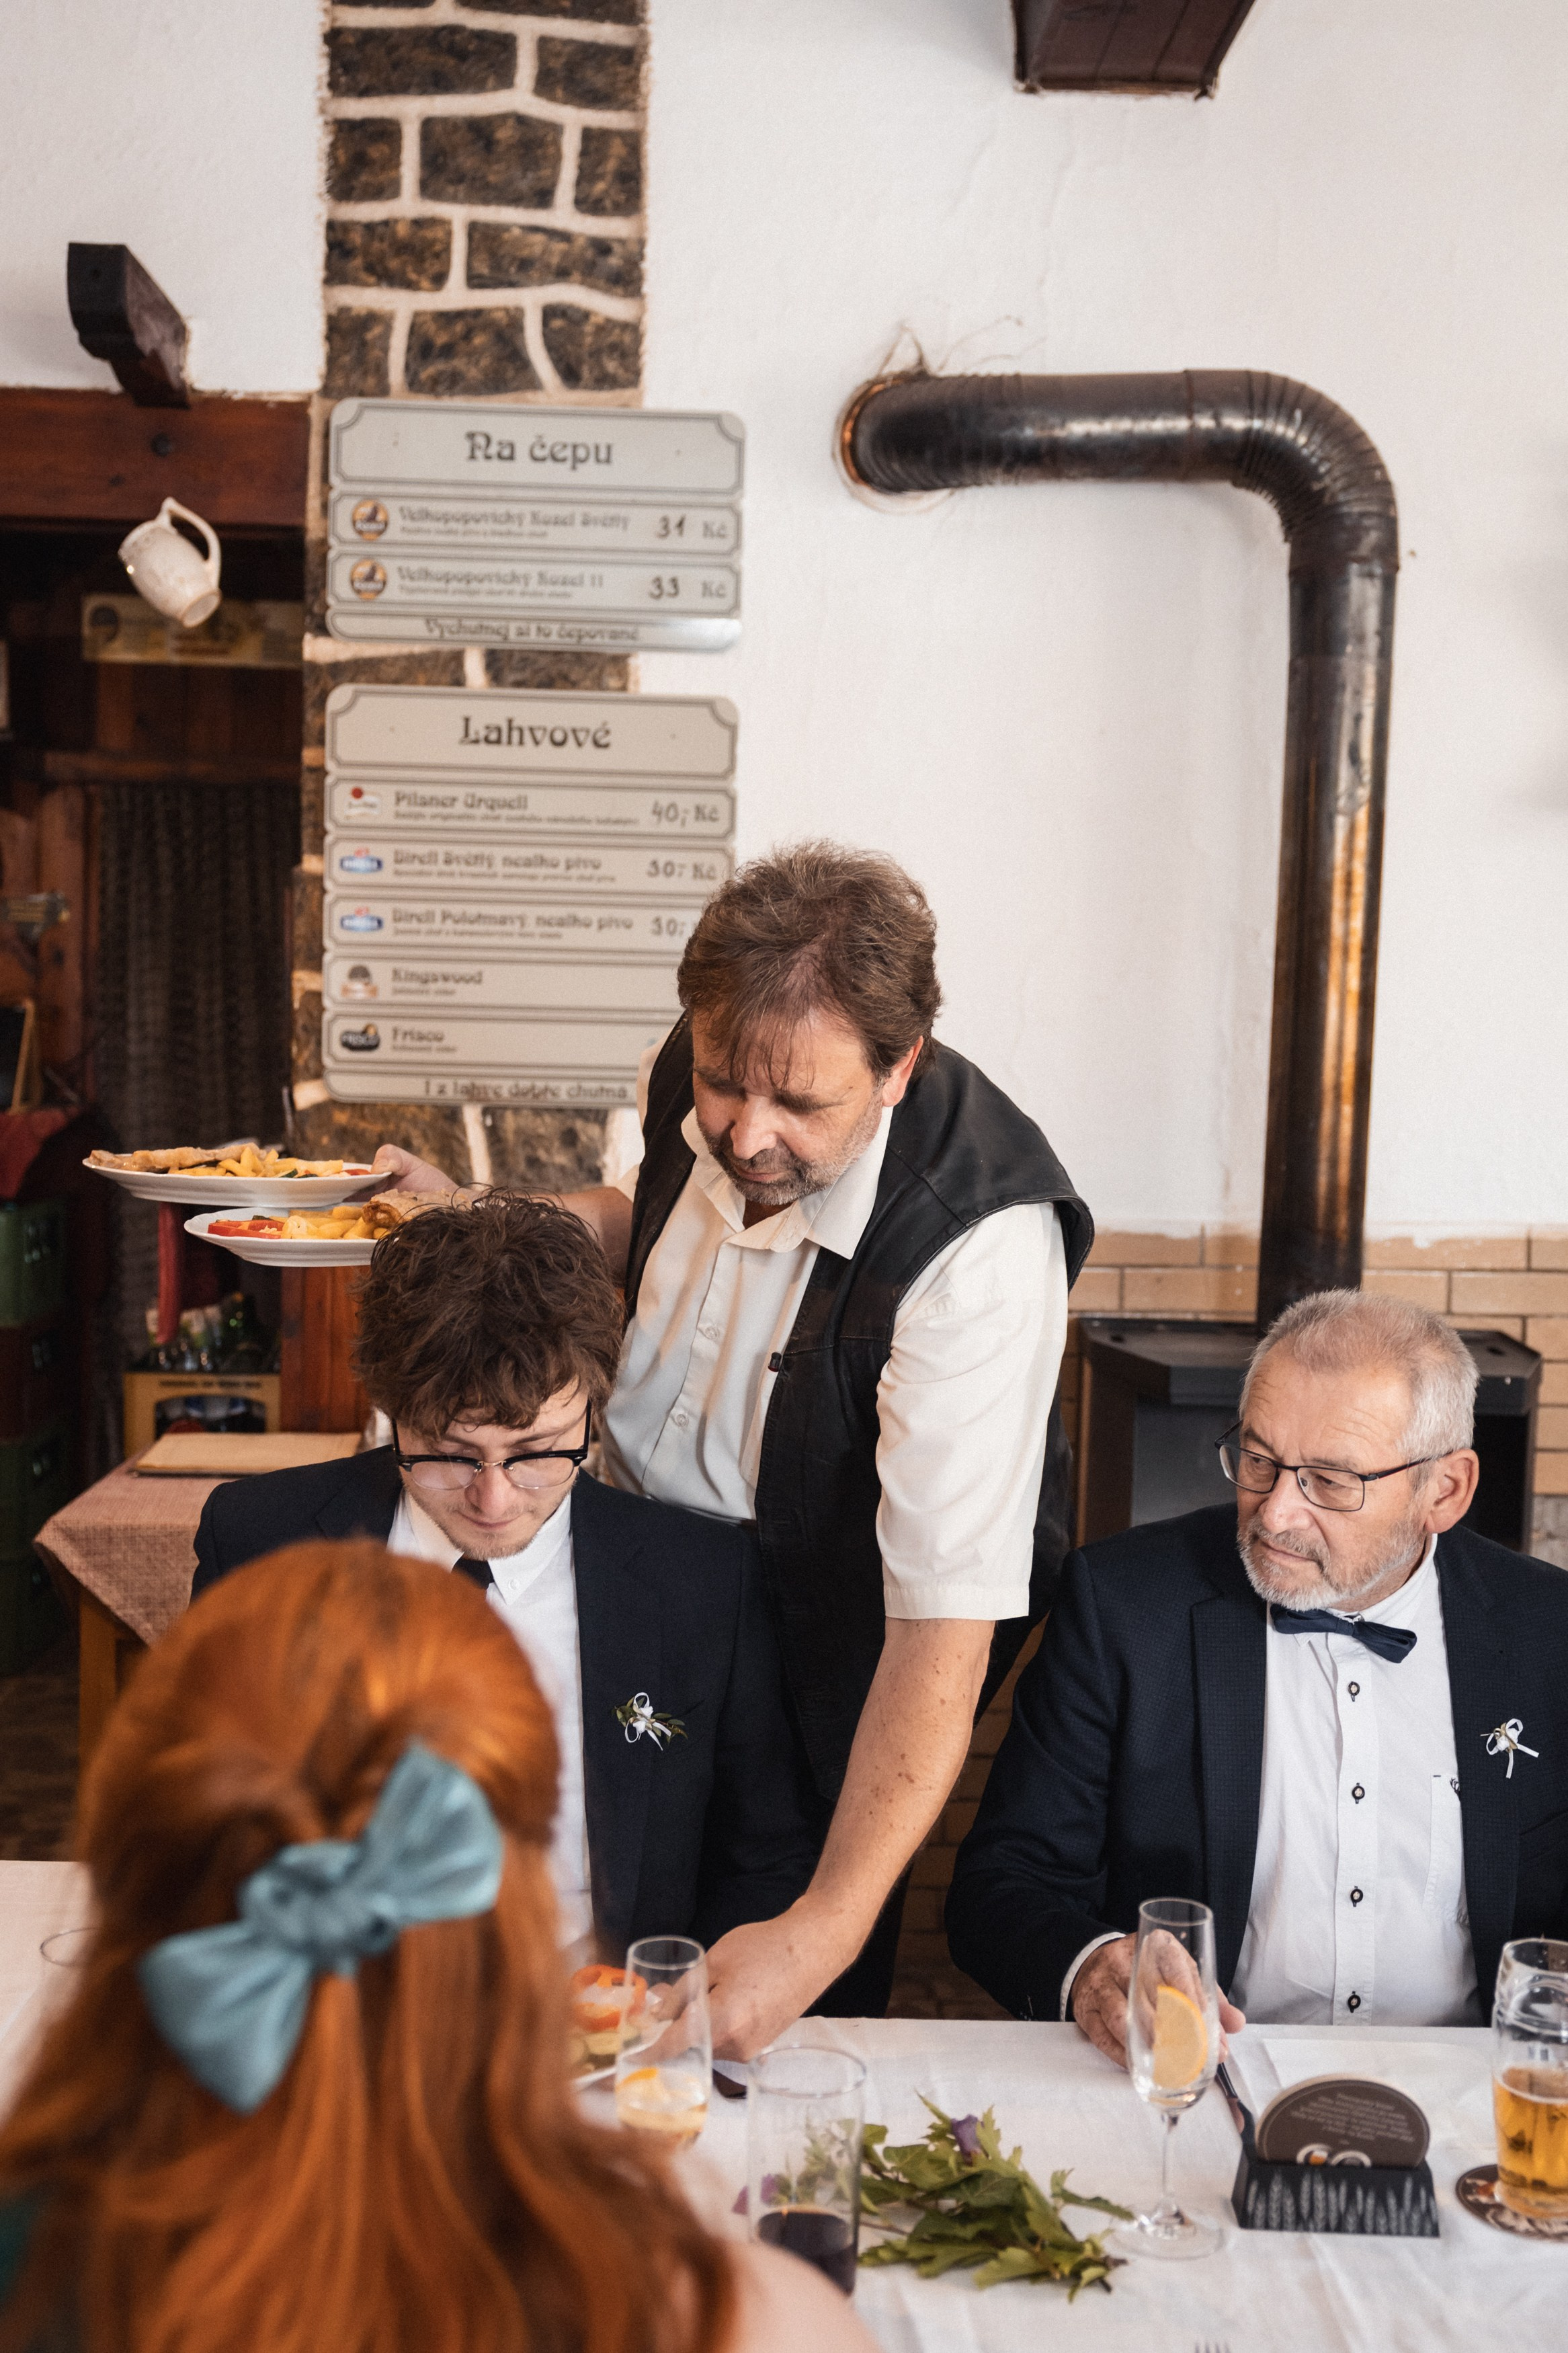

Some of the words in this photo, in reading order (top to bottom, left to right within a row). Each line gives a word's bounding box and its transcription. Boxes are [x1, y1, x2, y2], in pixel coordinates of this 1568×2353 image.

[465, 431, 515, 461] Na
[530, 436, 612, 471] čepu
[657, 513, 686, 539] 31
[649, 575, 679, 599] 33
[460, 716, 612, 749] Lahvové
[395, 791, 457, 807] Pilsner
[464, 793, 528, 811] Urquell
[392, 967, 483, 985] Kingswood
